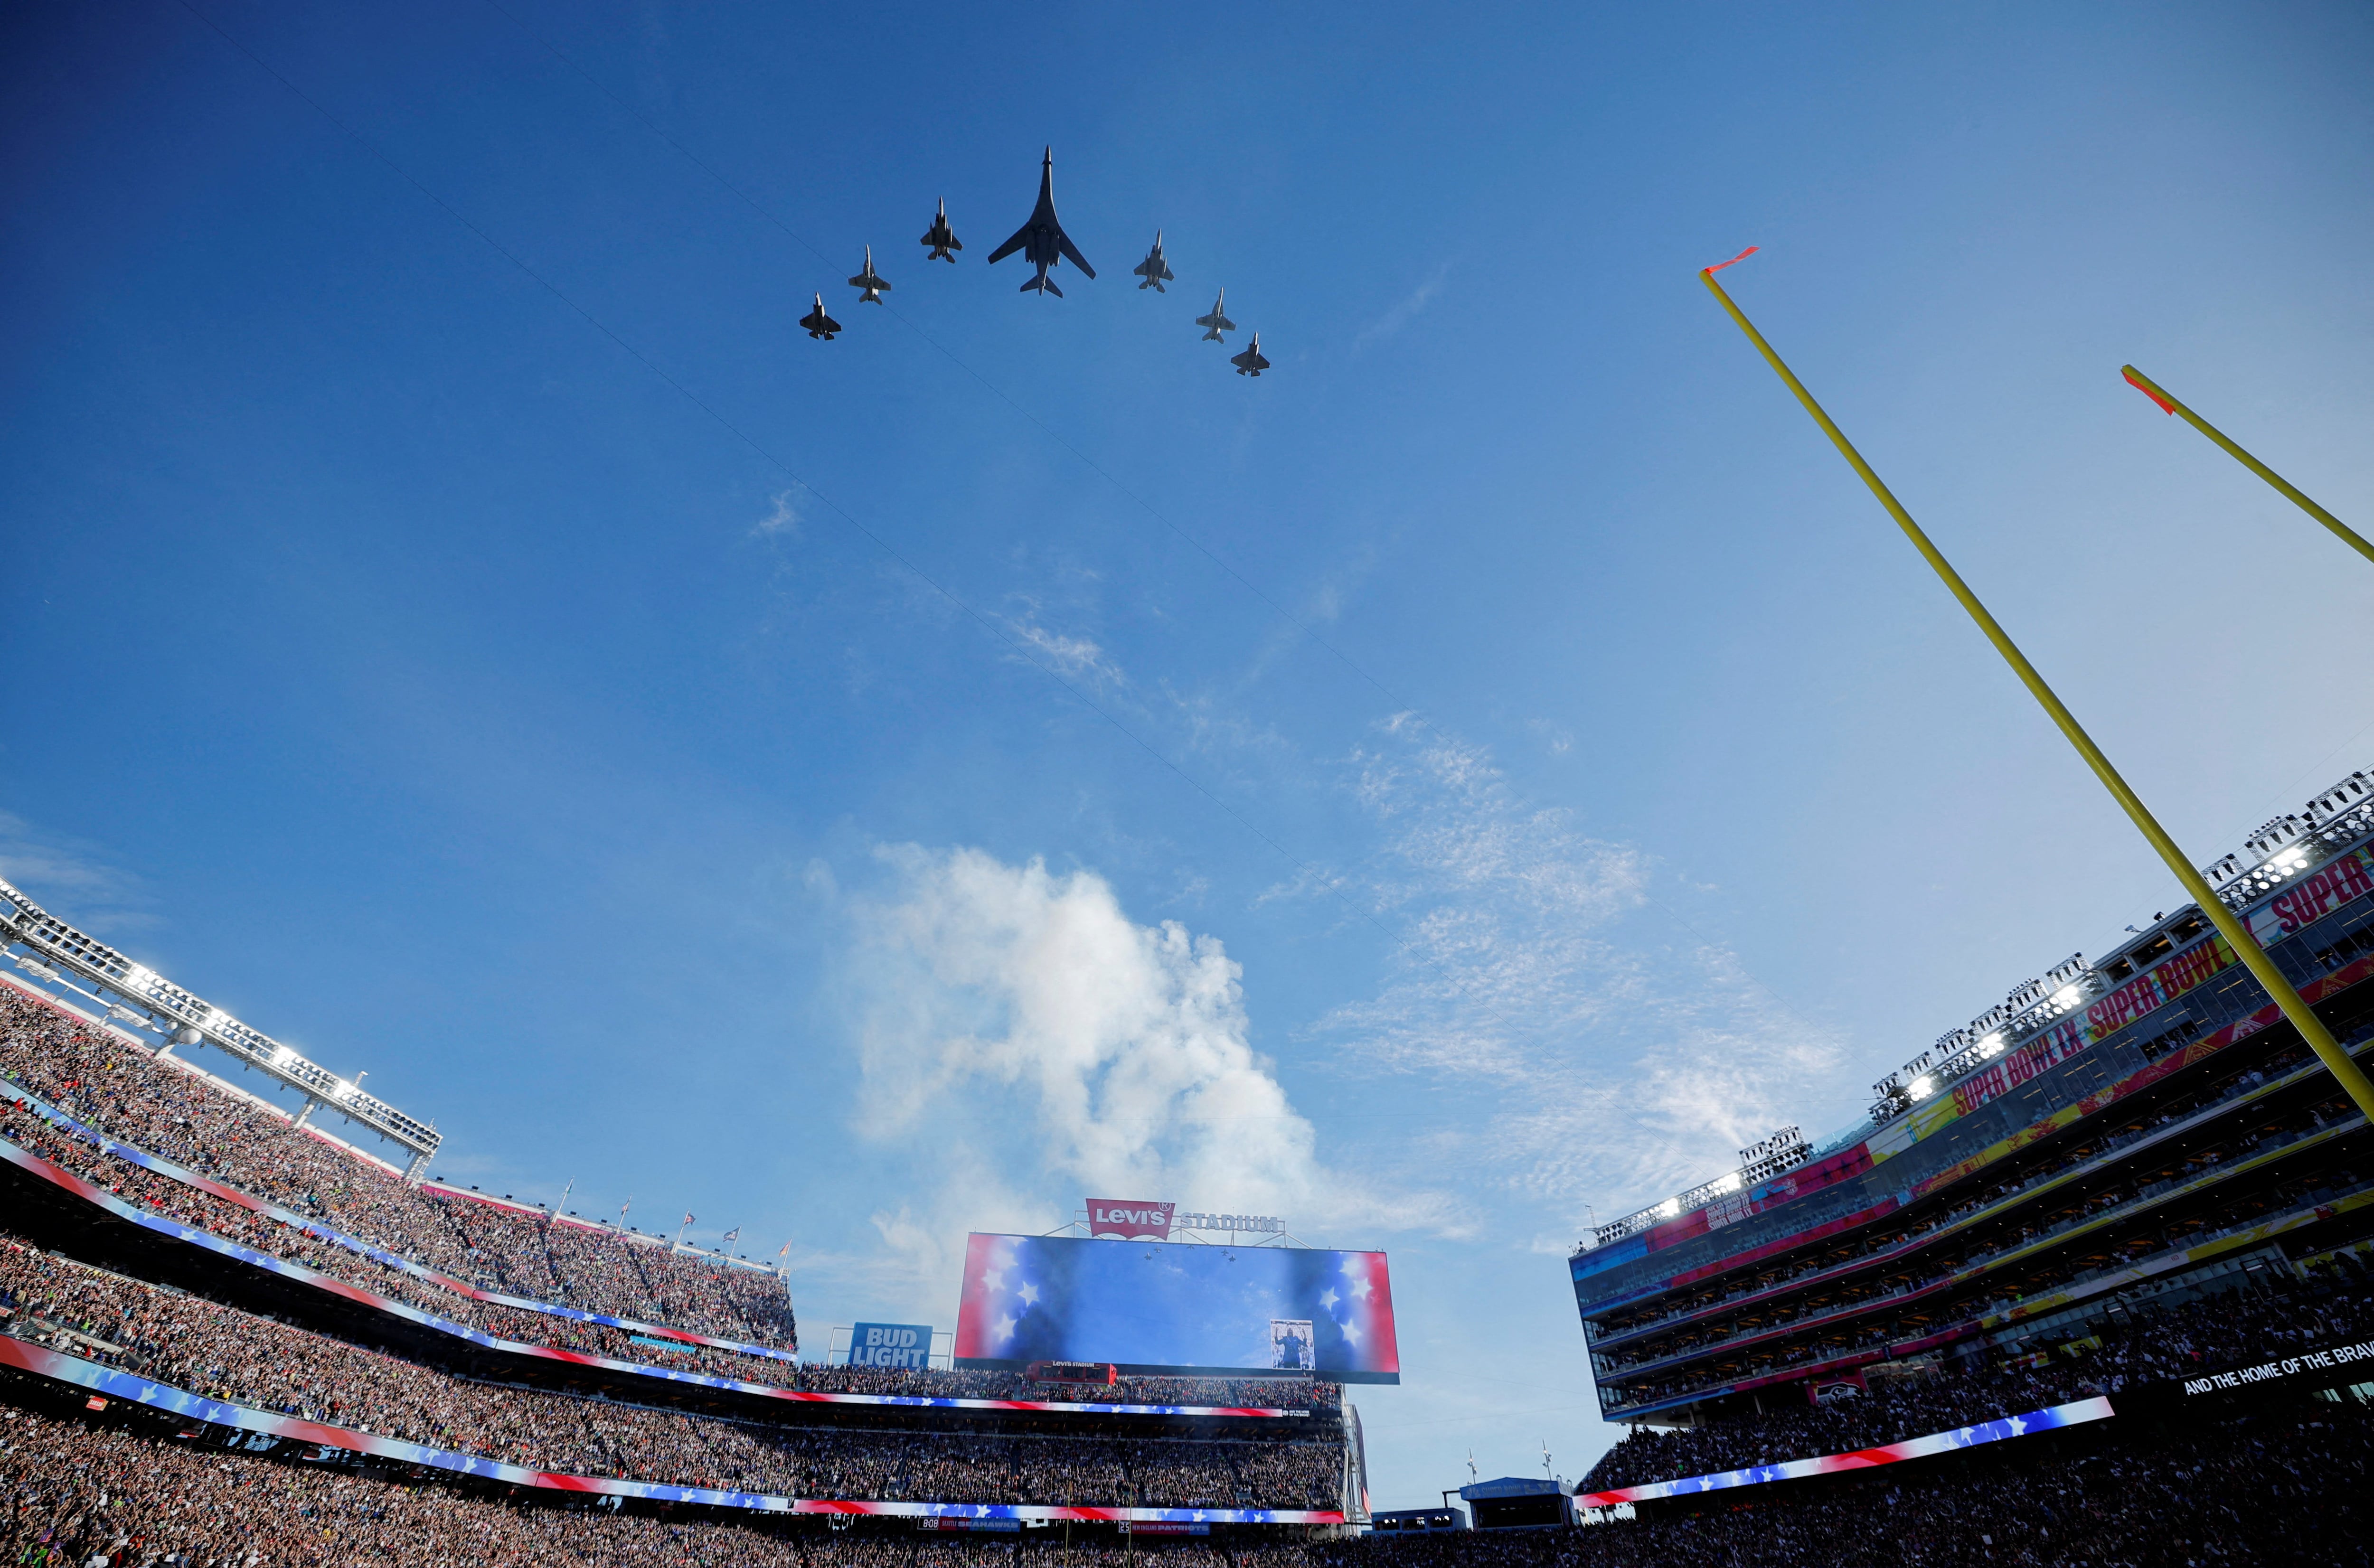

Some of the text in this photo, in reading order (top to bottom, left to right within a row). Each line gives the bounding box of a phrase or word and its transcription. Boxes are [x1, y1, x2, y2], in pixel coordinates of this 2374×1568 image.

[2271, 855, 2374, 933] SUPER
[2087, 975, 2162, 1039] SUPER
[2155, 937, 2228, 999] BOWL
[1952, 1064, 2008, 1117] SUPER
[2005, 1035, 2059, 1088] BOWL
[2054, 1018, 2084, 1059] LX
[1180, 1211, 1278, 1233] STADIUM
[1708, 1216, 1729, 1231] SUPER
[1728, 1210, 1746, 1223] BOWL
[866, 1328, 917, 1348] BUD
[853, 1346, 925, 1368] LIGHT
[2185, 1341, 2374, 1395] AND THE HOME OF THE BRAV
[1481, 1483, 1553, 1494] SUPER BOWL LX
[923, 1519, 938, 1528] 8:08
[1120, 1522, 1130, 1531] 25
